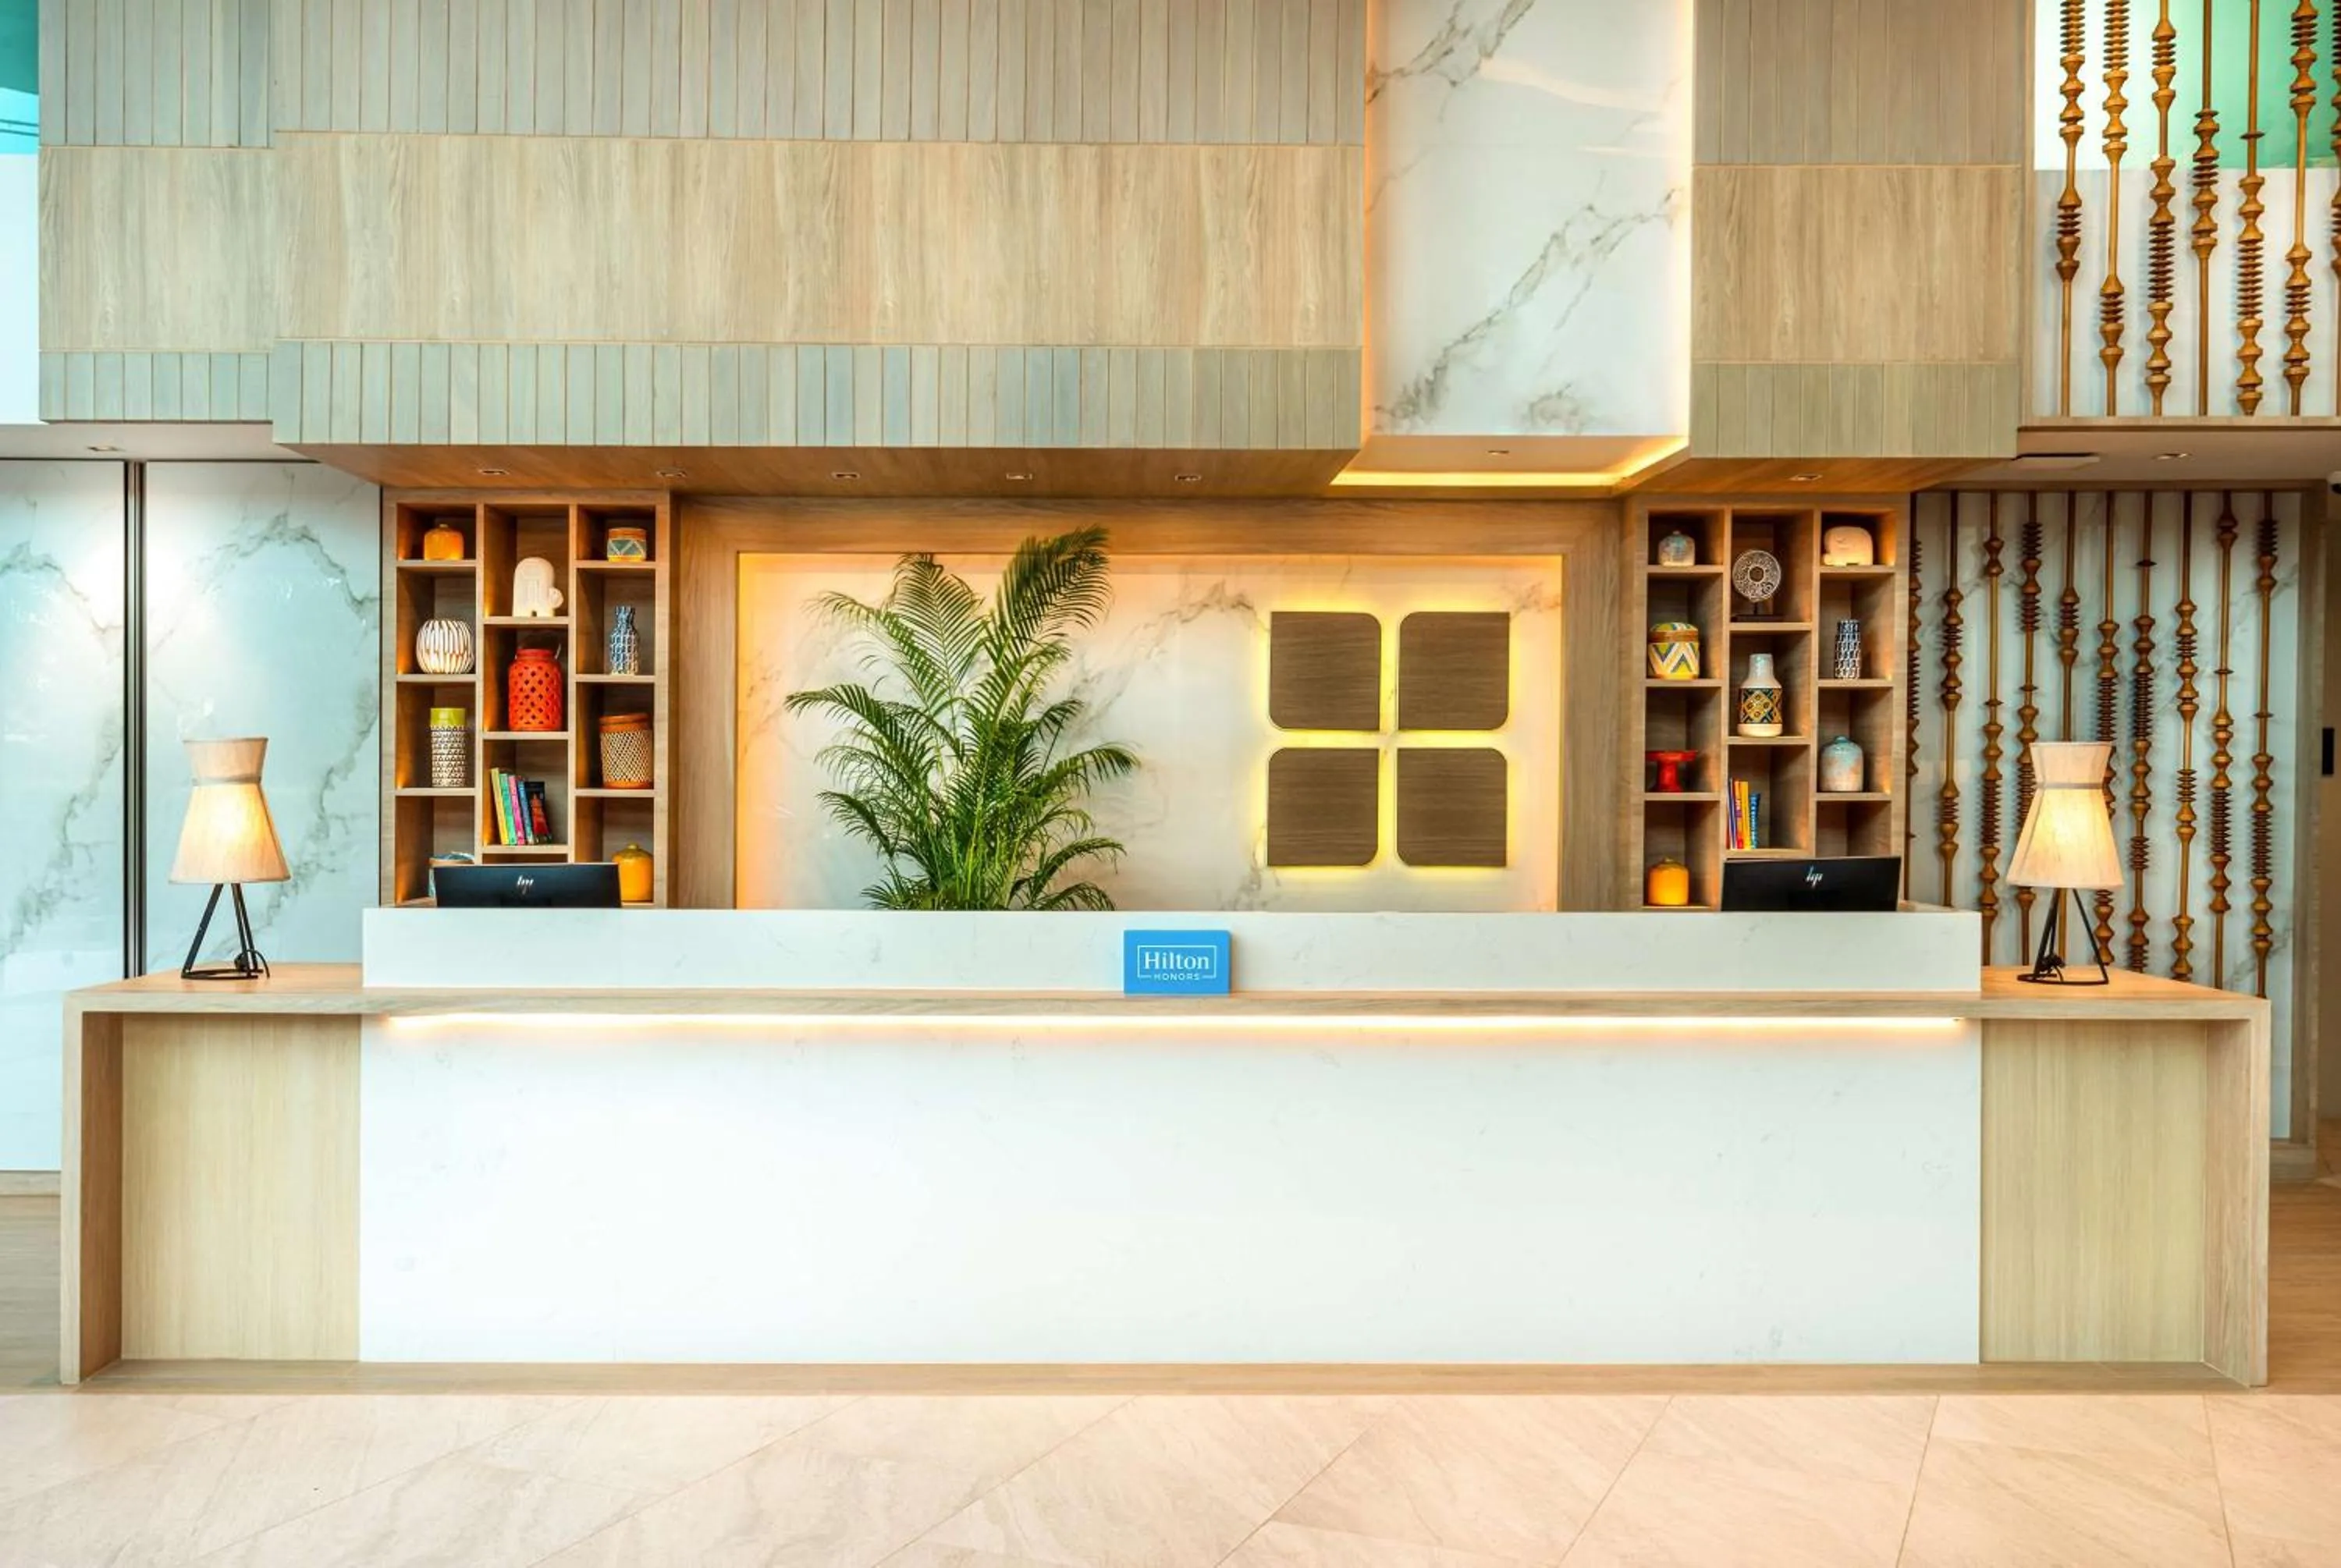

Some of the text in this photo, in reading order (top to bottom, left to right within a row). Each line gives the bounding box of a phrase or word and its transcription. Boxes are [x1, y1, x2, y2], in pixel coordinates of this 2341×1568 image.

[517, 874, 534, 895] hp
[1806, 864, 1823, 888] hp
[1144, 951, 1210, 970] Hilton
[1153, 973, 1200, 981] HONORS
